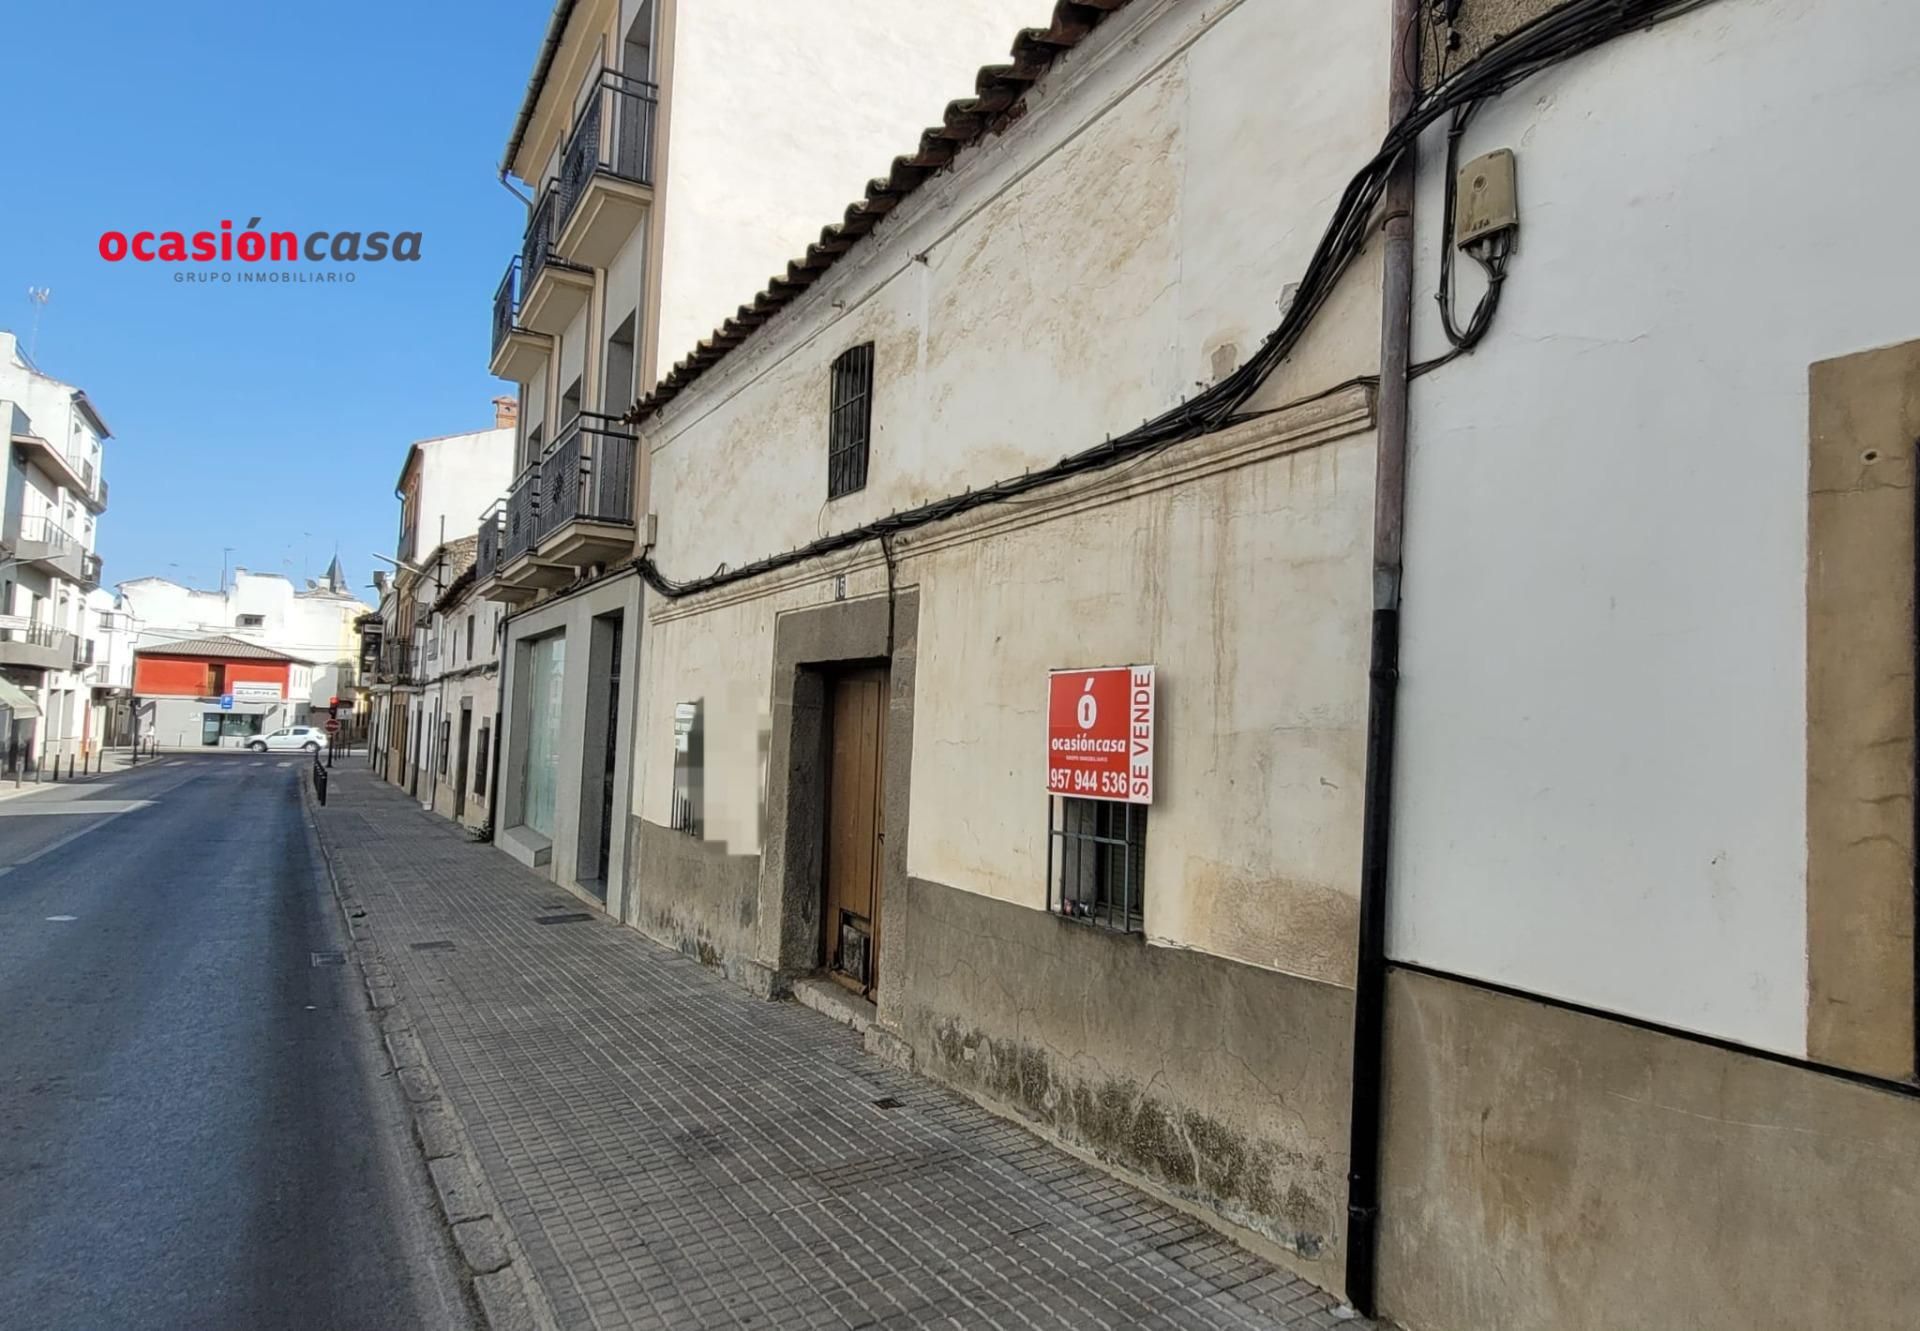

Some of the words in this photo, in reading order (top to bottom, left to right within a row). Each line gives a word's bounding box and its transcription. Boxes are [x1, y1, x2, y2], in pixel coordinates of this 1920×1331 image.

[1132, 670, 1151, 756] VENDE
[1051, 733, 1126, 753] ocasióncasa
[1050, 768, 1071, 789] 957
[1074, 769, 1098, 791] 944
[1101, 771, 1127, 794] 536
[1132, 764, 1149, 796] SE
